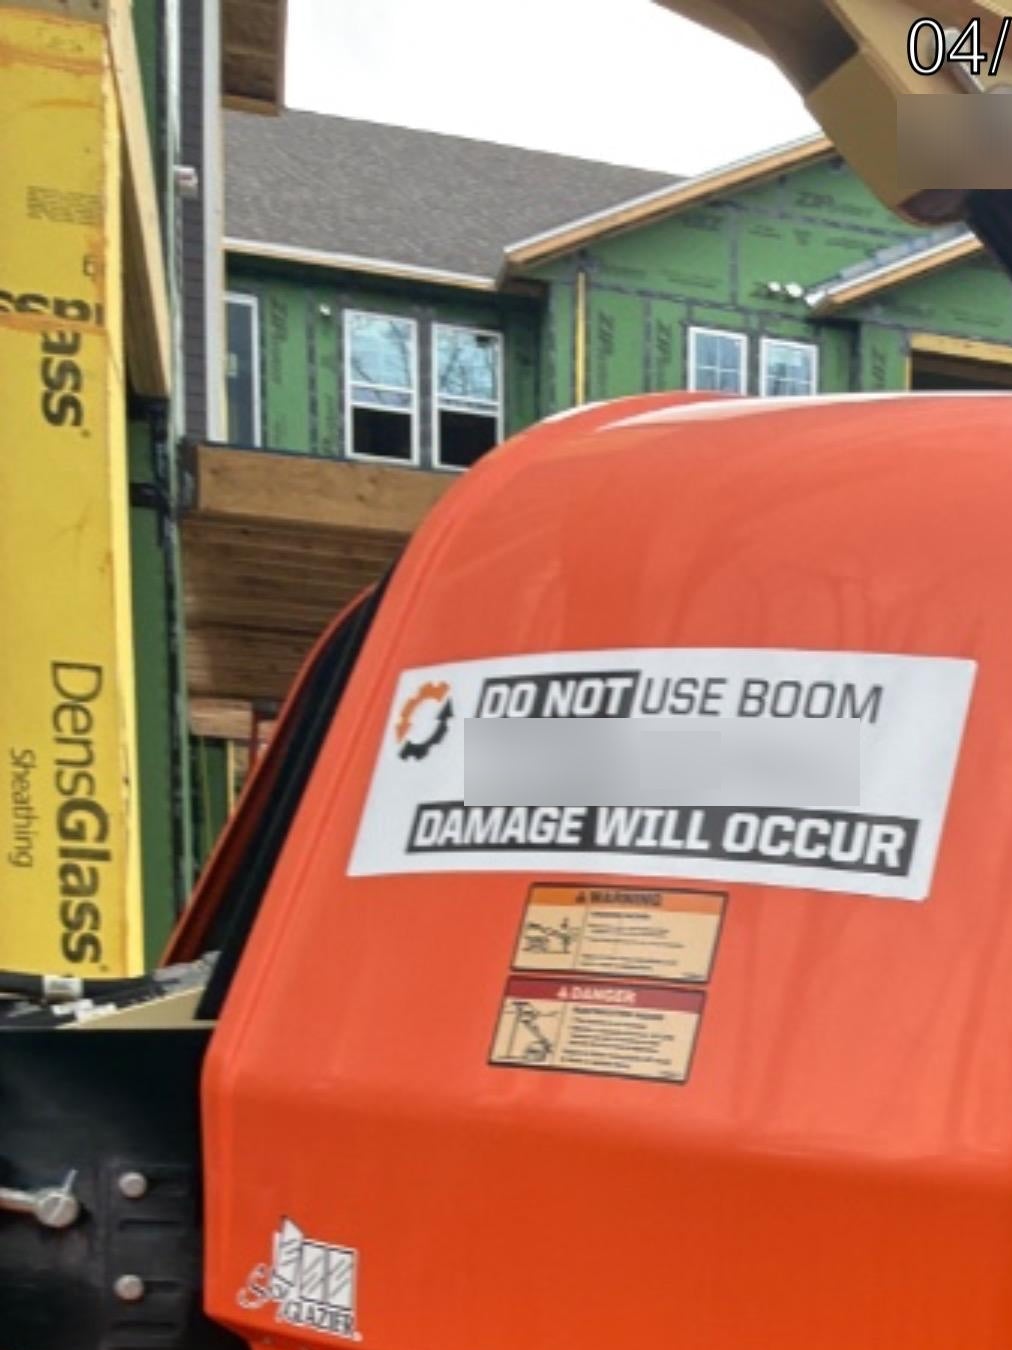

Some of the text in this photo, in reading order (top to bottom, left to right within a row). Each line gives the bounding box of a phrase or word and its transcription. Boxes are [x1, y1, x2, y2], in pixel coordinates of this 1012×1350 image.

[480, 677, 884, 724] DO NOT USE BOOM
[9, 748, 41, 868] Sheathing
[50, 660, 112, 965] DensGlass
[412, 806, 907, 868] DAMAGE WILL OCCUR
[571, 986, 638, 1004] DANGER
